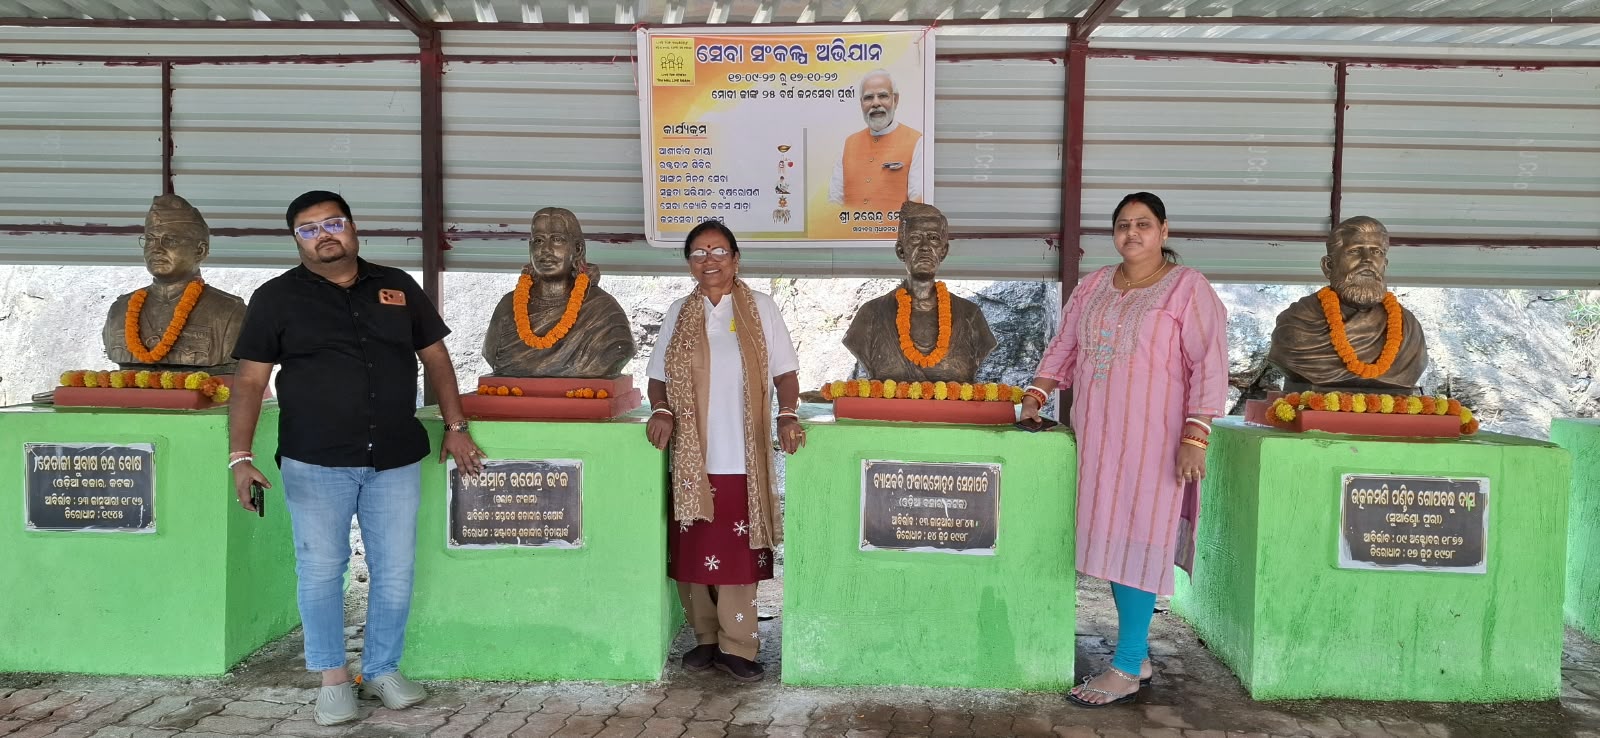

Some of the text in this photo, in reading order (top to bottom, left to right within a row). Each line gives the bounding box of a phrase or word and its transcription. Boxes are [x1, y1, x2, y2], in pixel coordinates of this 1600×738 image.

[696, 37, 883, 64] ସେବା ସଂକଳ୍ପ ଅଭିଯାନ
[779, 73, 787, 85] ରୁ
[711, 89, 737, 99] ମୋଦୀ
[763, 90, 775, 99] ୨୫
[780, 87, 794, 99] ବର୍ଷ
[797, 89, 834, 99] ଜନସେବା
[663, 124, 707, 136] କାର୍ଯ୍ୟକ୍ରମ
[659, 146, 690, 156] ଆଶୀର୍ବାଦ
[692, 159, 711, 170] ଶିବିର
[708, 175, 728, 183] ସେବା
[660, 202, 680, 210] ସେବା
[660, 215, 693, 224] ଜନସେବା
[839, 212, 849, 224] ଶ୍ରୀ
[853, 212, 883, 224] ନରେନ୍ଦ୍ର
[38, 456, 70, 470] ନେତାଜୀ
[101, 456, 115, 474] ଚନ୍ଦ୍ର
[110, 479, 134, 488] କଟକ)
[874, 469, 904, 489] ବ୍ୟାସକବି
[957, 471, 988, 492] ସେନାପତି
[45, 493, 71, 505] ଆବିର୍ଭାବ
[1392, 484, 1414, 512] ପଣ୍ଡିତ
[1418, 491, 1455, 514] ଗୋପବନ୍ଧୁ
[65, 507, 95, 519] ତିରୋଧାନ
[463, 526, 489, 537] ତିରୋଧାନ
[896, 527, 922, 540] ତିରୋଧାନ
[1364, 530, 1390, 542] ଆବିର୍ଭାବ
[1370, 544, 1401, 558] ତିରୋଧାନ
